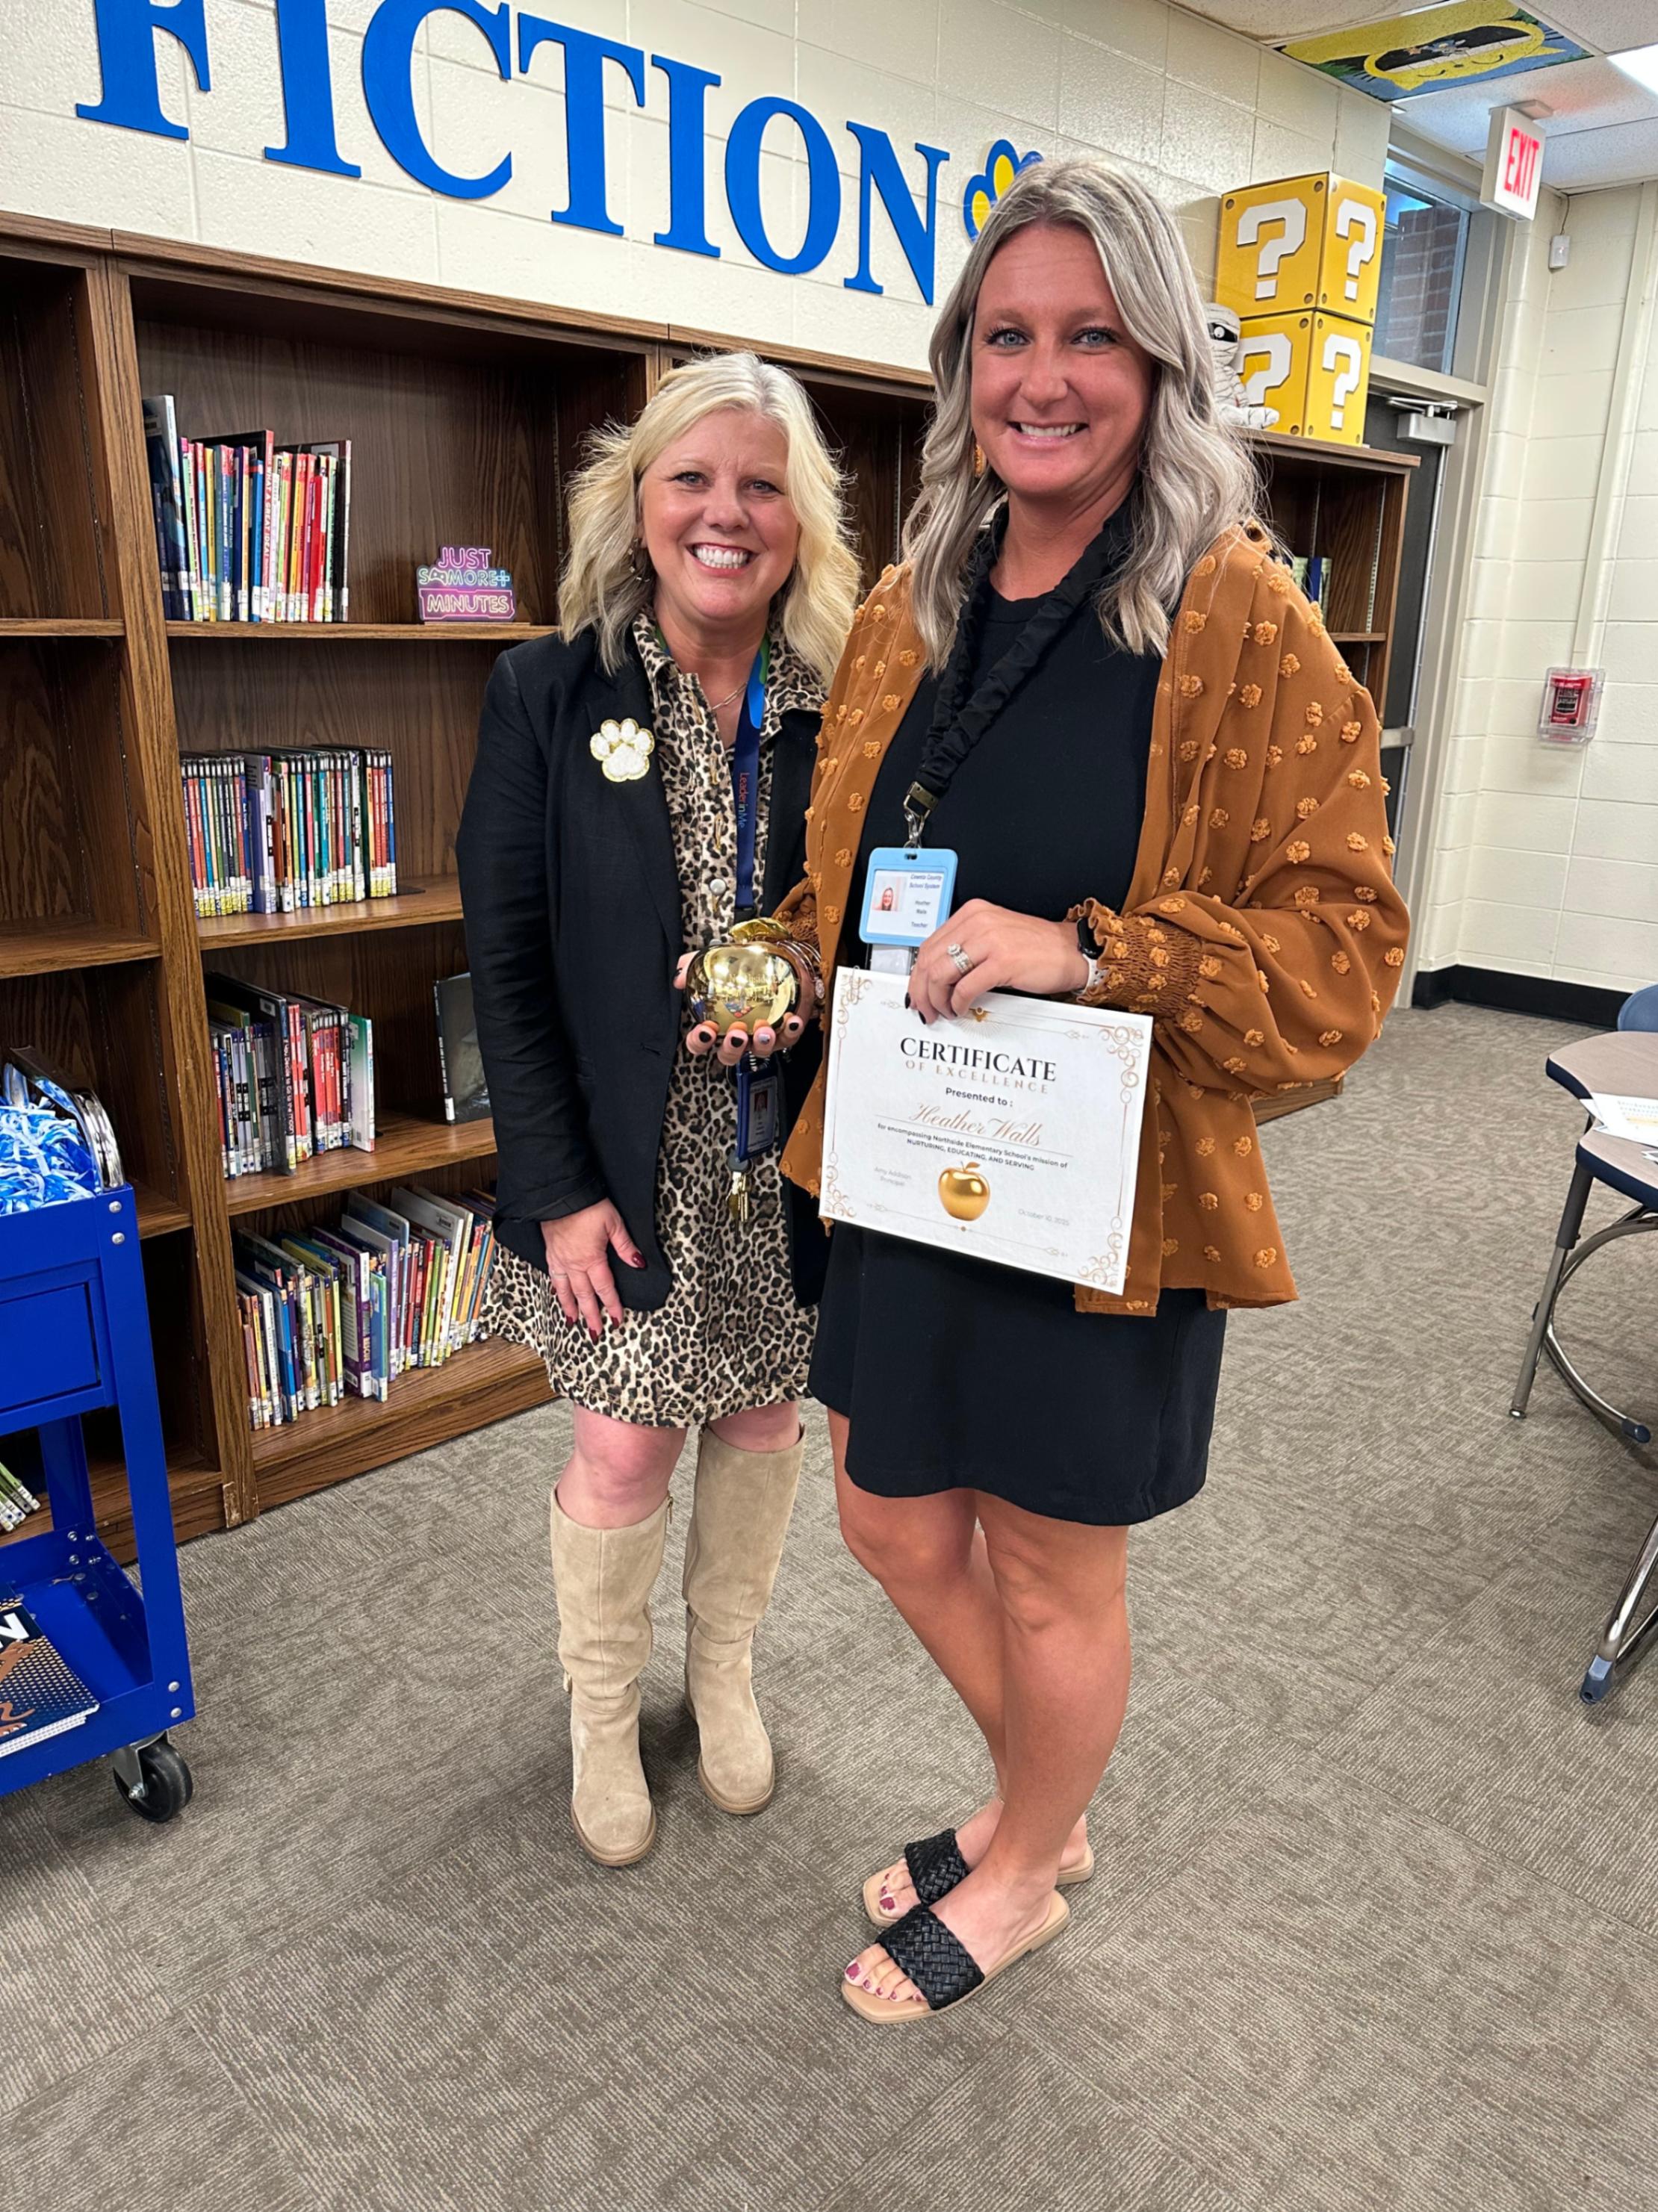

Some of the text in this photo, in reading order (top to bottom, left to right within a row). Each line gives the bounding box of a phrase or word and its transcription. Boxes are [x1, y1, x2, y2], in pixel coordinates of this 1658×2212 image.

[75, 0, 950, 306] FICTION
[1504, 127, 1540, 202] EXIT
[438, 547, 491, 570] JUST
[447, 569, 497, 586] MORE
[427, 594, 509, 613] MINUTES
[901, 1037, 1057, 1082] CERTIFICATE
[905, 1060, 1049, 1094] OF EXCELLENCE
[946, 1087, 995, 1104] Presented
[997, 1096, 1008, 1106] to
[909, 1102, 1043, 1147] Heather Walls
[887, 1126, 931, 1140] encompassing
[933, 1135, 964, 1147] Northside
[965, 1142, 1002, 1155] Elementary
[1004, 1150, 1031, 1161] School's
[1032, 1156, 1058, 1166] mission
[907, 1139, 946, 1152] NURTURING,
[988, 1156, 1004, 1164] AND
[1005, 1159, 1034, 1171] SERVING
